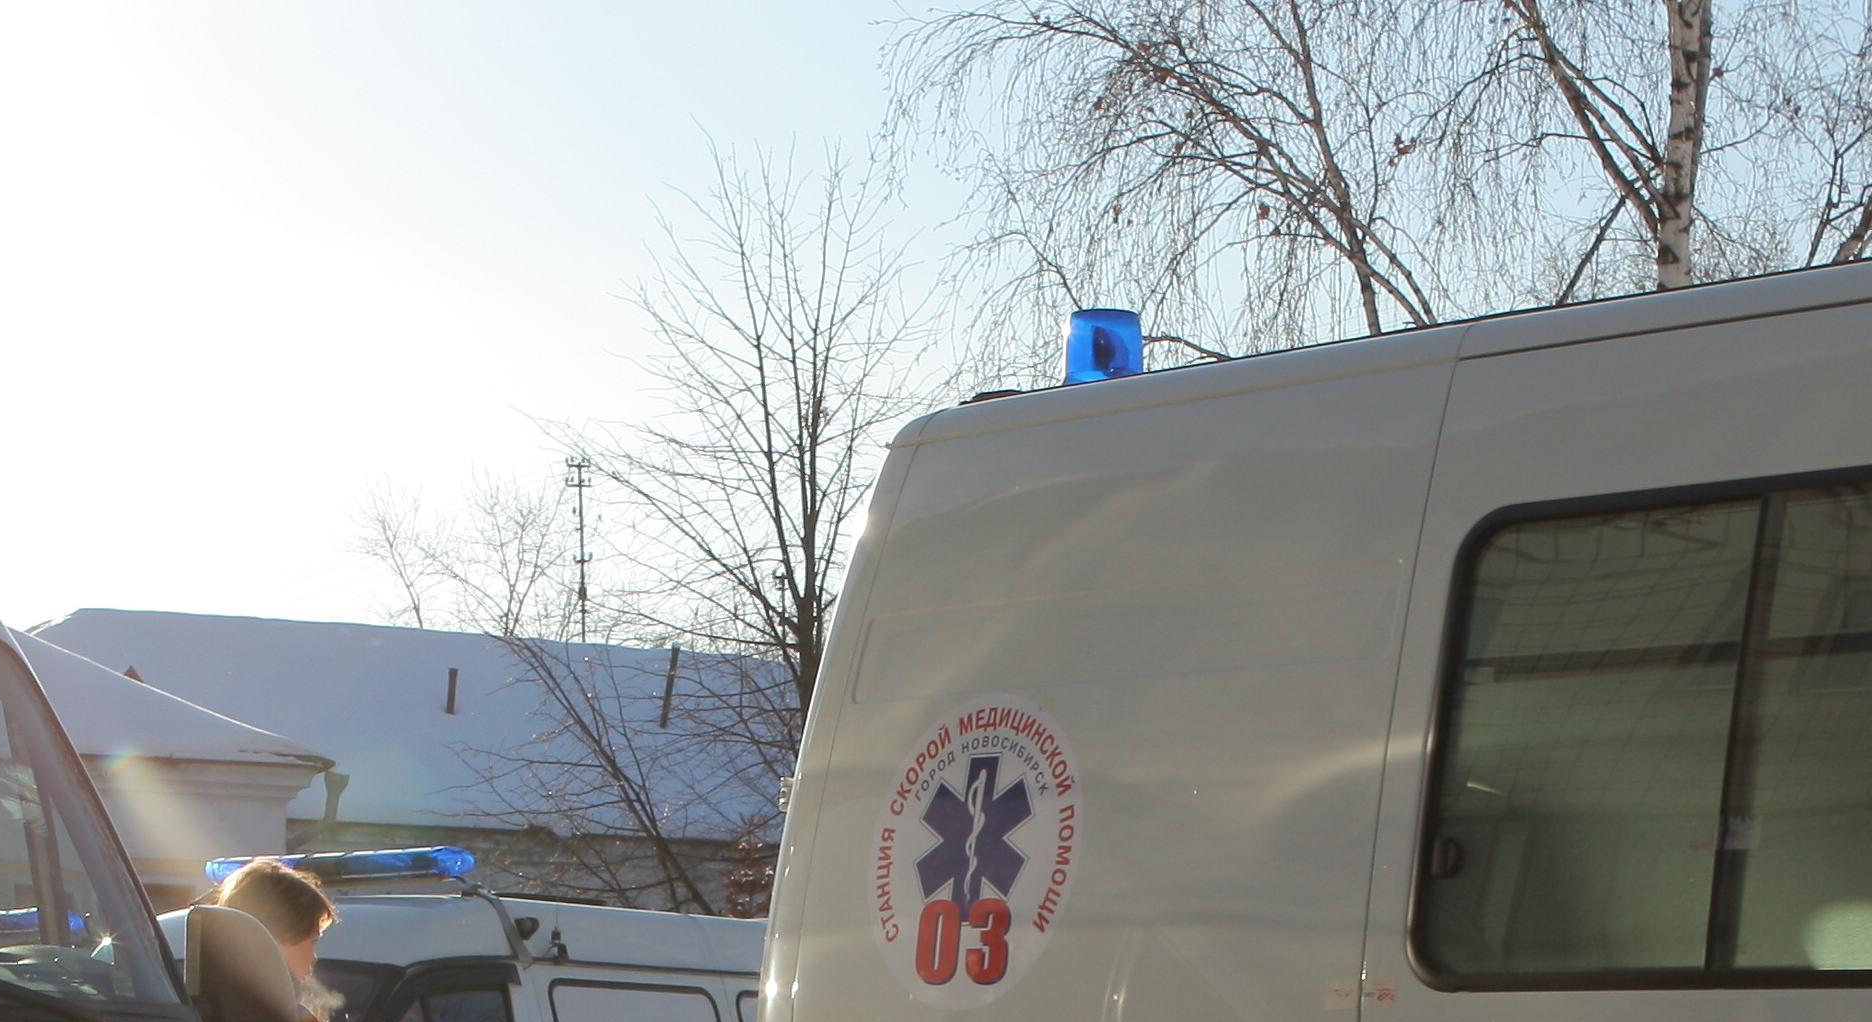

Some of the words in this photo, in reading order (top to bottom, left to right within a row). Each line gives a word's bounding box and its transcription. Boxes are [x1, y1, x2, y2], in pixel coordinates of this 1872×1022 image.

[914, 750, 957, 802] ГОРОД
[961, 735, 1050, 797] НОВОСИБИРСК
[876, 827, 900, 943] СТАНЦИЯ
[890, 724, 952, 817] СКОРОЙ
[958, 706, 1076, 797] МЕДИЦИНСКОЙ
[1032, 804, 1075, 934] ПОМОЩИ
[915, 898, 1012, 986] 03
